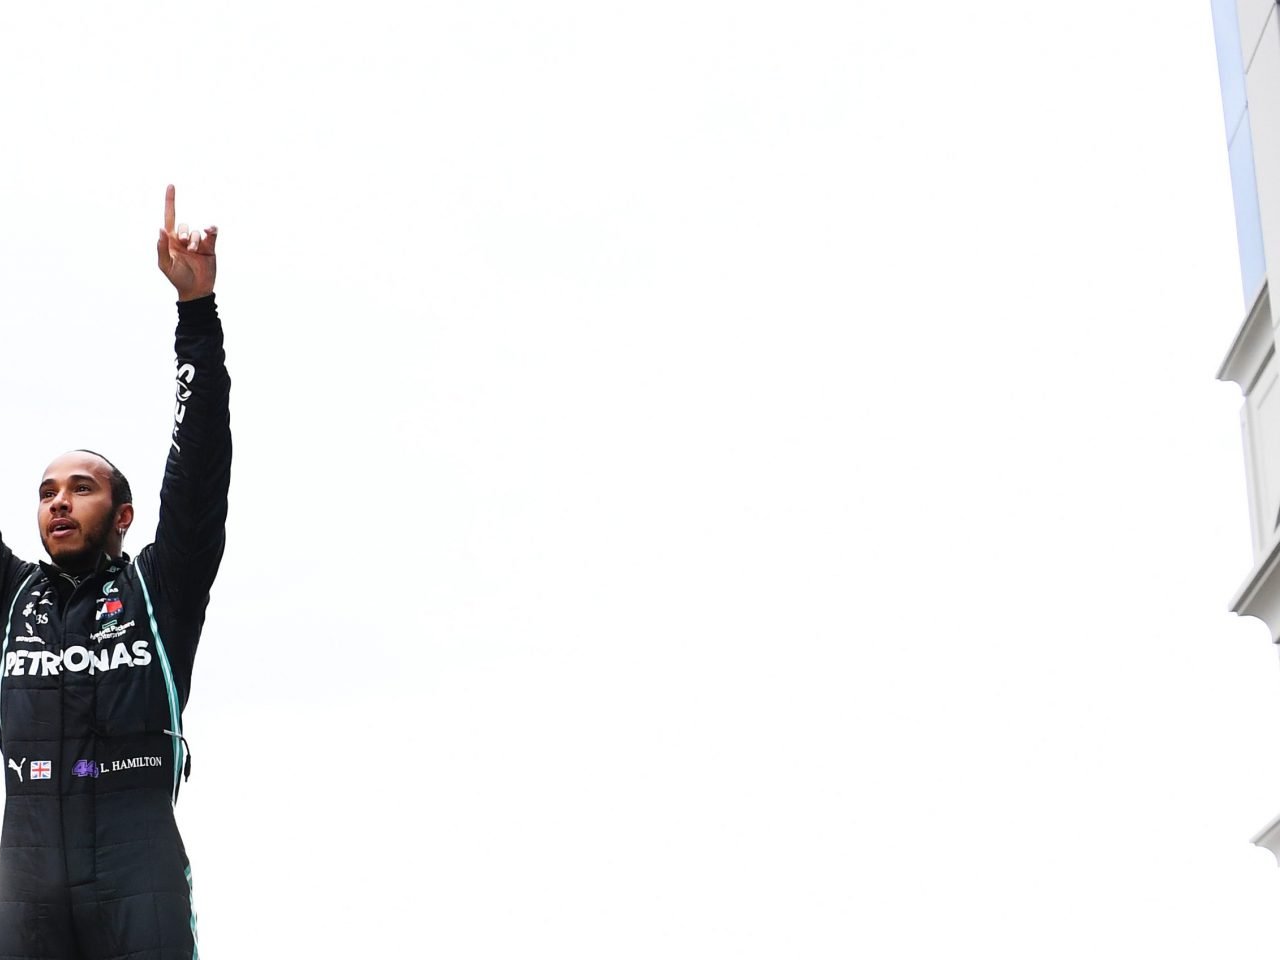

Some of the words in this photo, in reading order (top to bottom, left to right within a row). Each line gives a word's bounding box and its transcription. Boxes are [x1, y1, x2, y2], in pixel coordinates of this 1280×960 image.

[4, 640, 152, 677] PETRONAS
[101, 763, 110, 773] L.
[112, 756, 163, 772] HAMILTON
